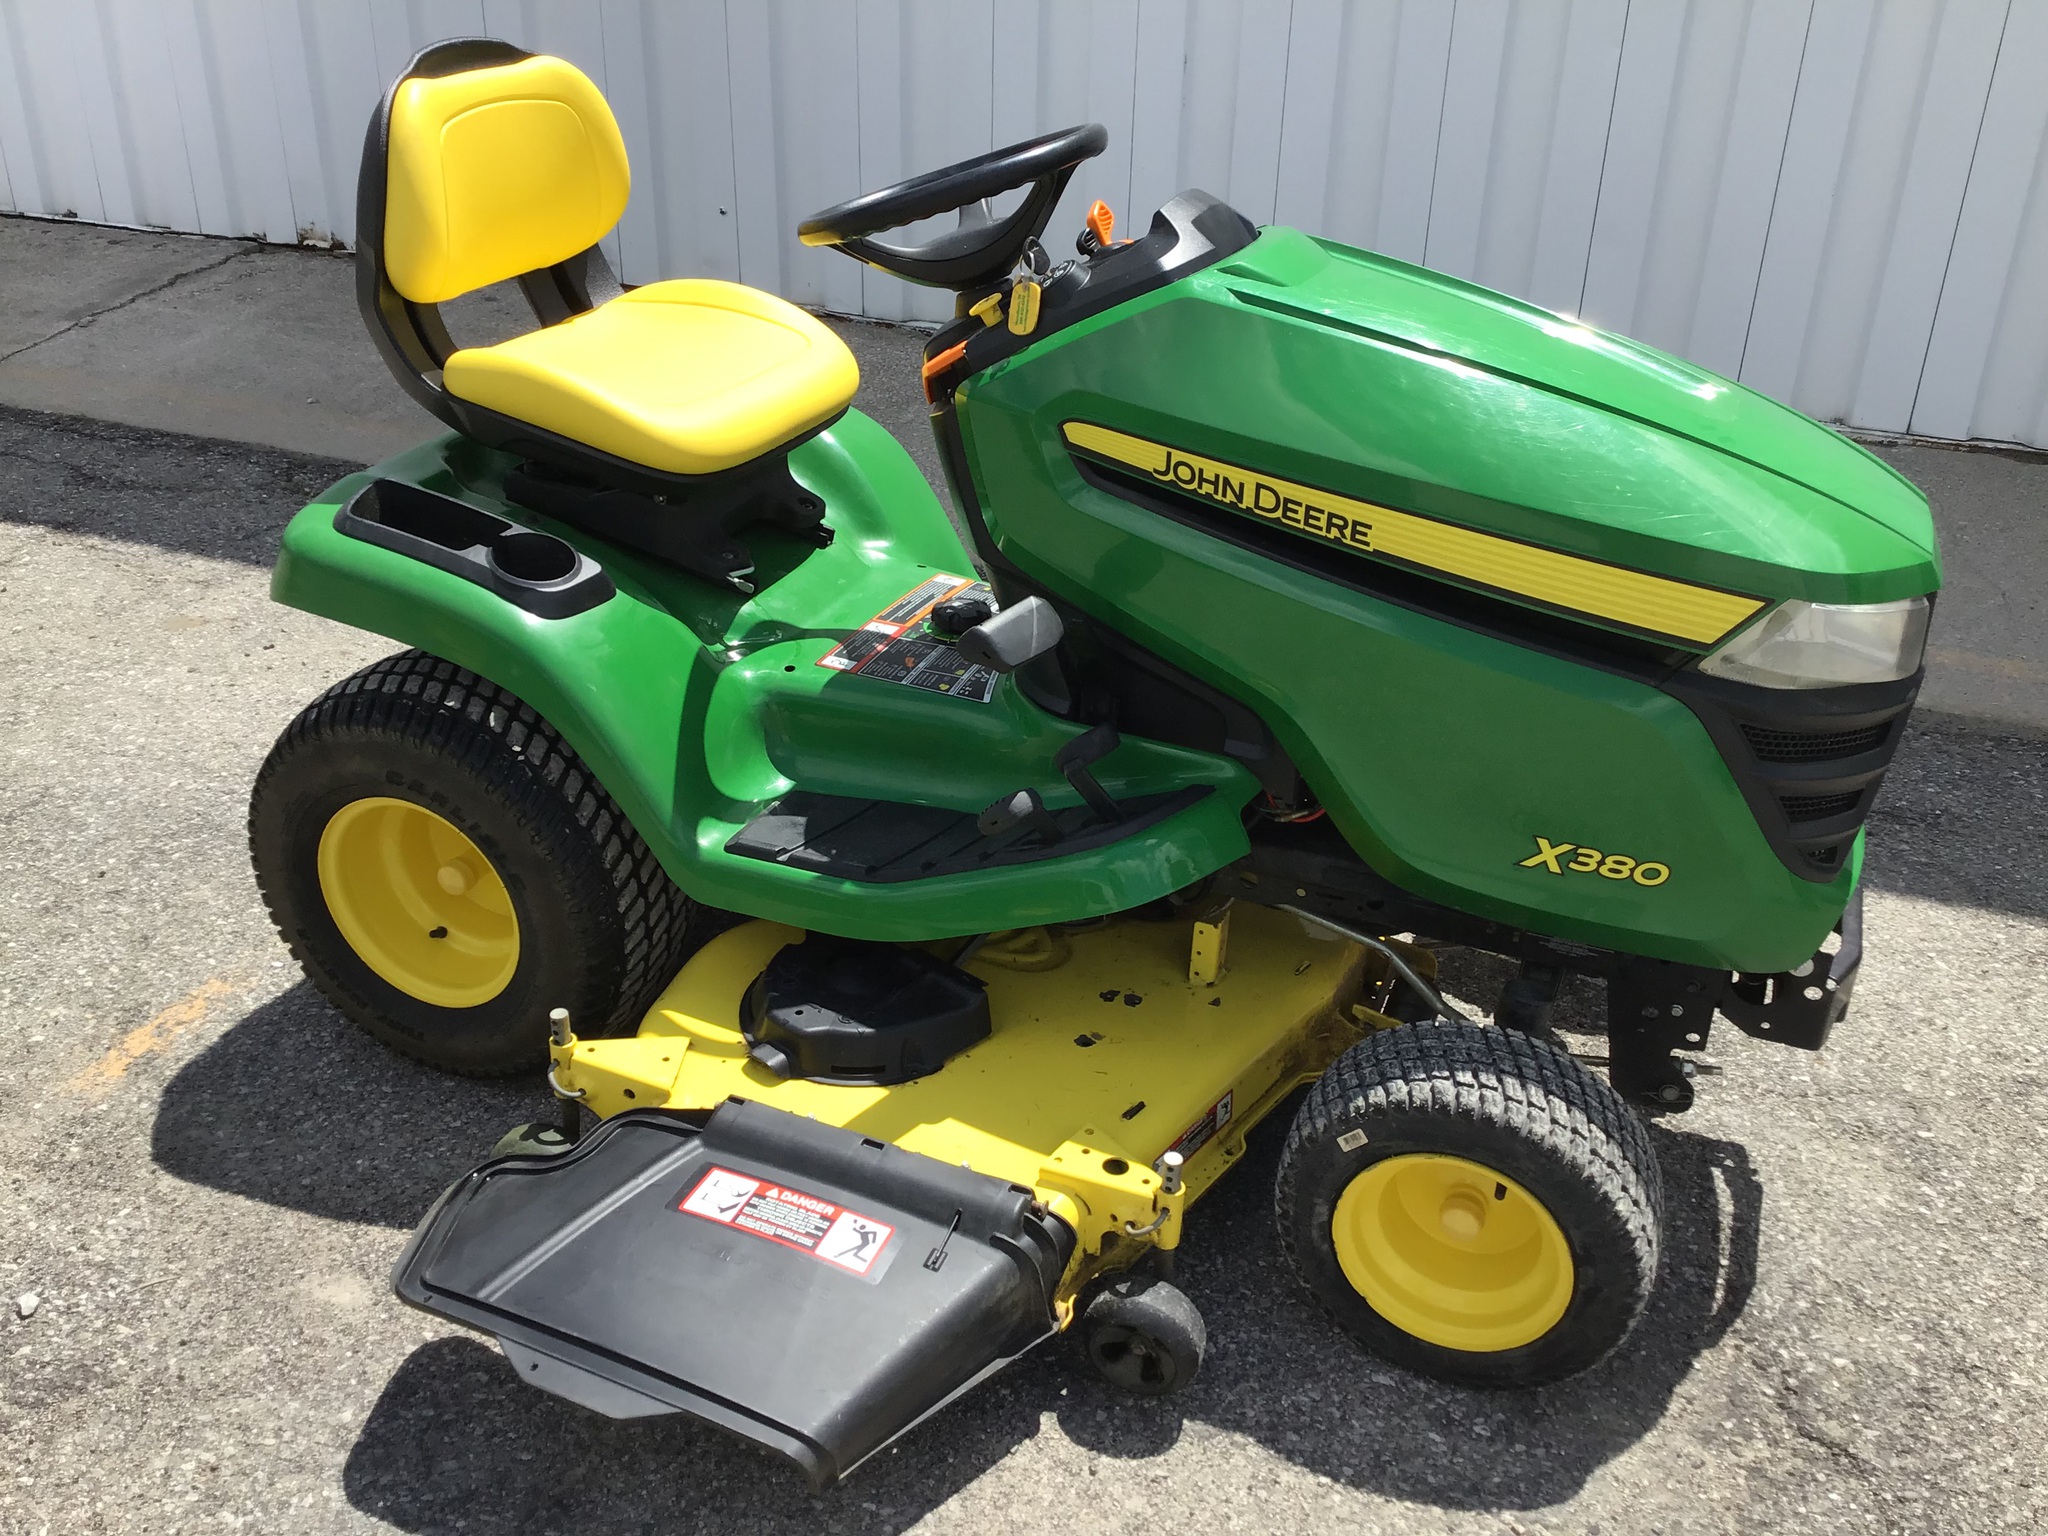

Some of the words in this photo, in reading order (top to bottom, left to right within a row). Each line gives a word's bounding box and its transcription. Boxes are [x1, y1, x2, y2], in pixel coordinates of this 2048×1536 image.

[1153, 451, 1245, 507] JOHN
[1254, 483, 1374, 549] DEERE
[1515, 835, 1672, 887] X380
[780, 1191, 835, 1216] DANGER
